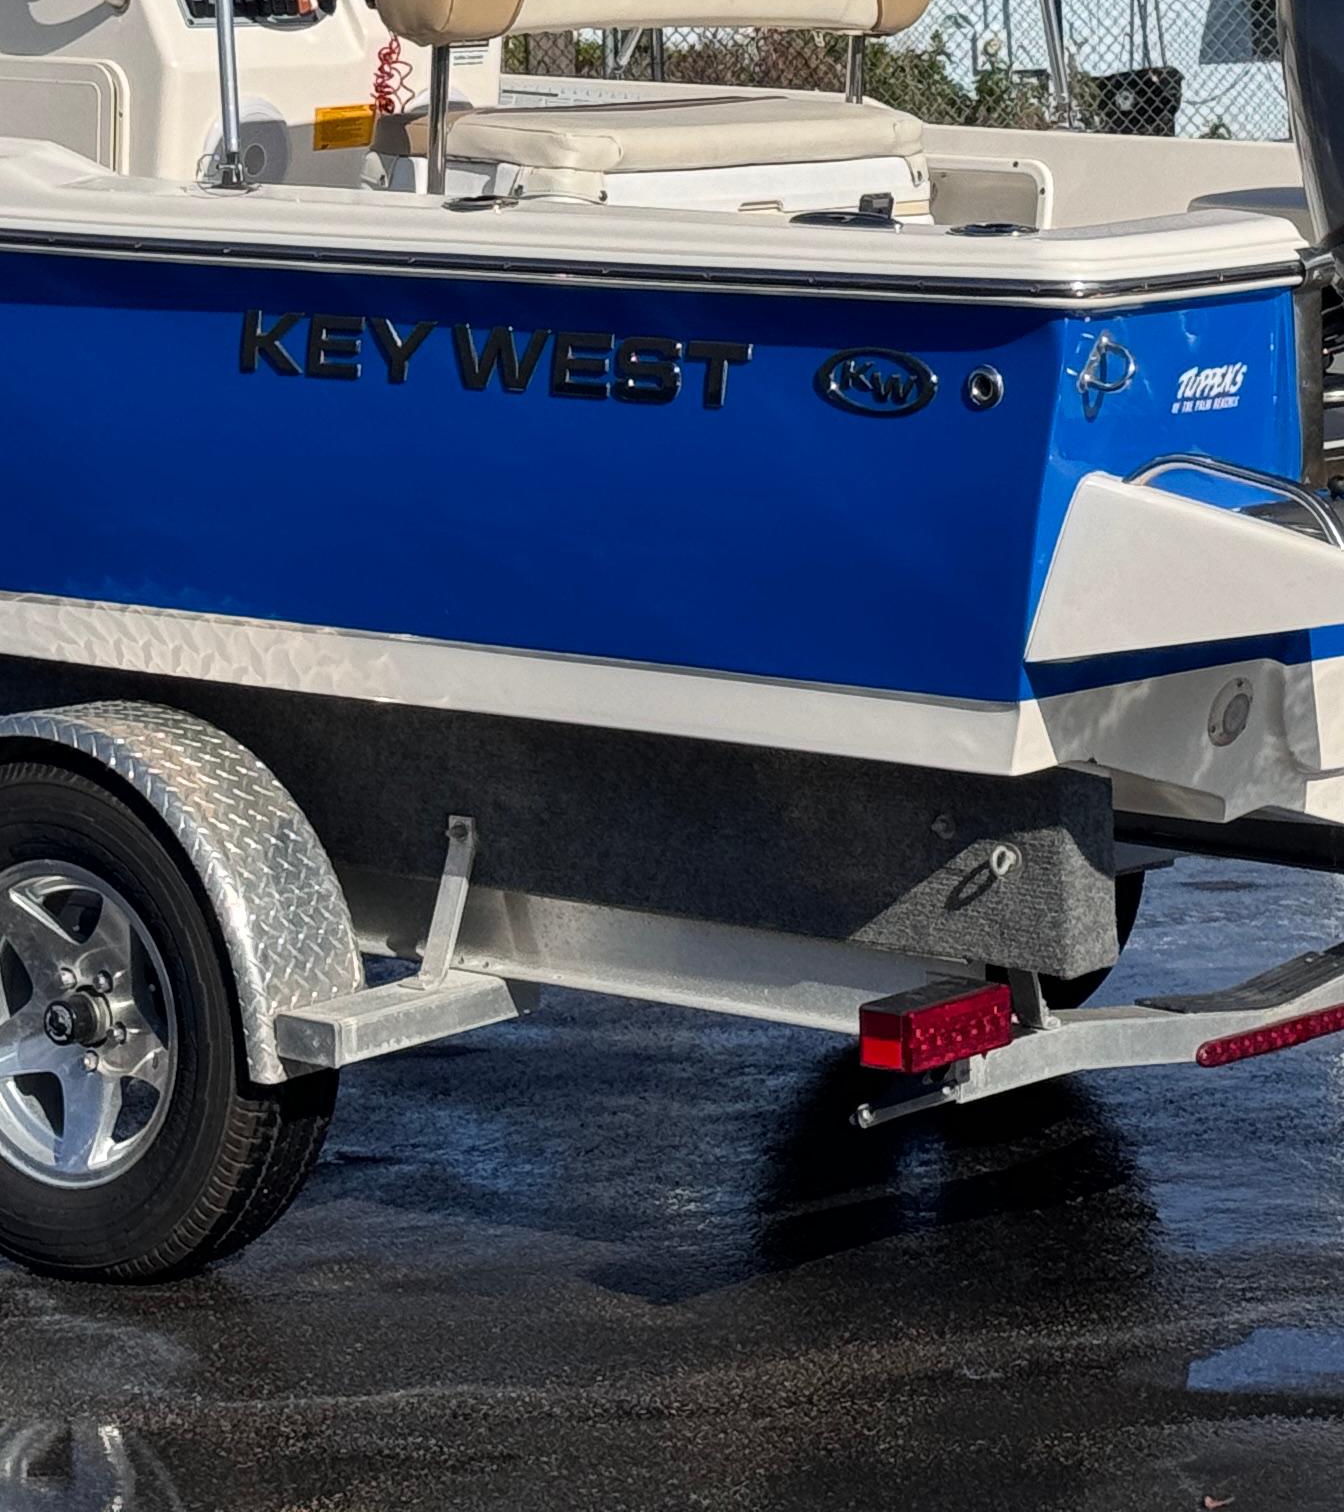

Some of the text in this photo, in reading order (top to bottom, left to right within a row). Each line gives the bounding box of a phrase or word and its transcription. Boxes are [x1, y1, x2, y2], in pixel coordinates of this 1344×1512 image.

[239, 309, 754, 410] KEY WEST
[840, 359, 918, 405] KW
